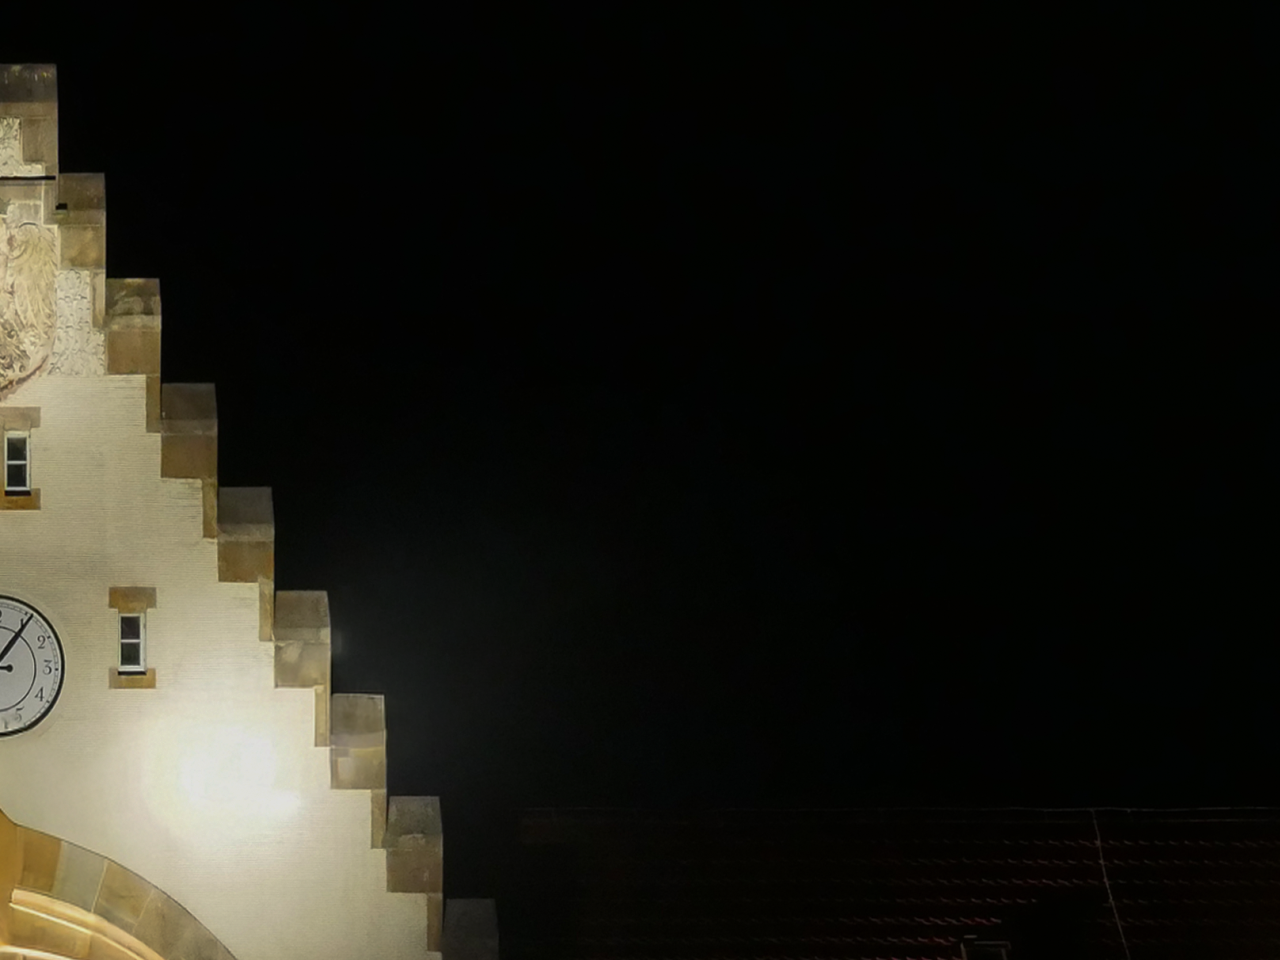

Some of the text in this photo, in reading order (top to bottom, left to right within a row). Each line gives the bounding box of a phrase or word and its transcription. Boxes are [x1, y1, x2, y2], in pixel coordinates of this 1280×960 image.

[37, 635, 46, 649] 2
[43, 659, 53, 675] 3
[34, 687, 45, 702] 4
